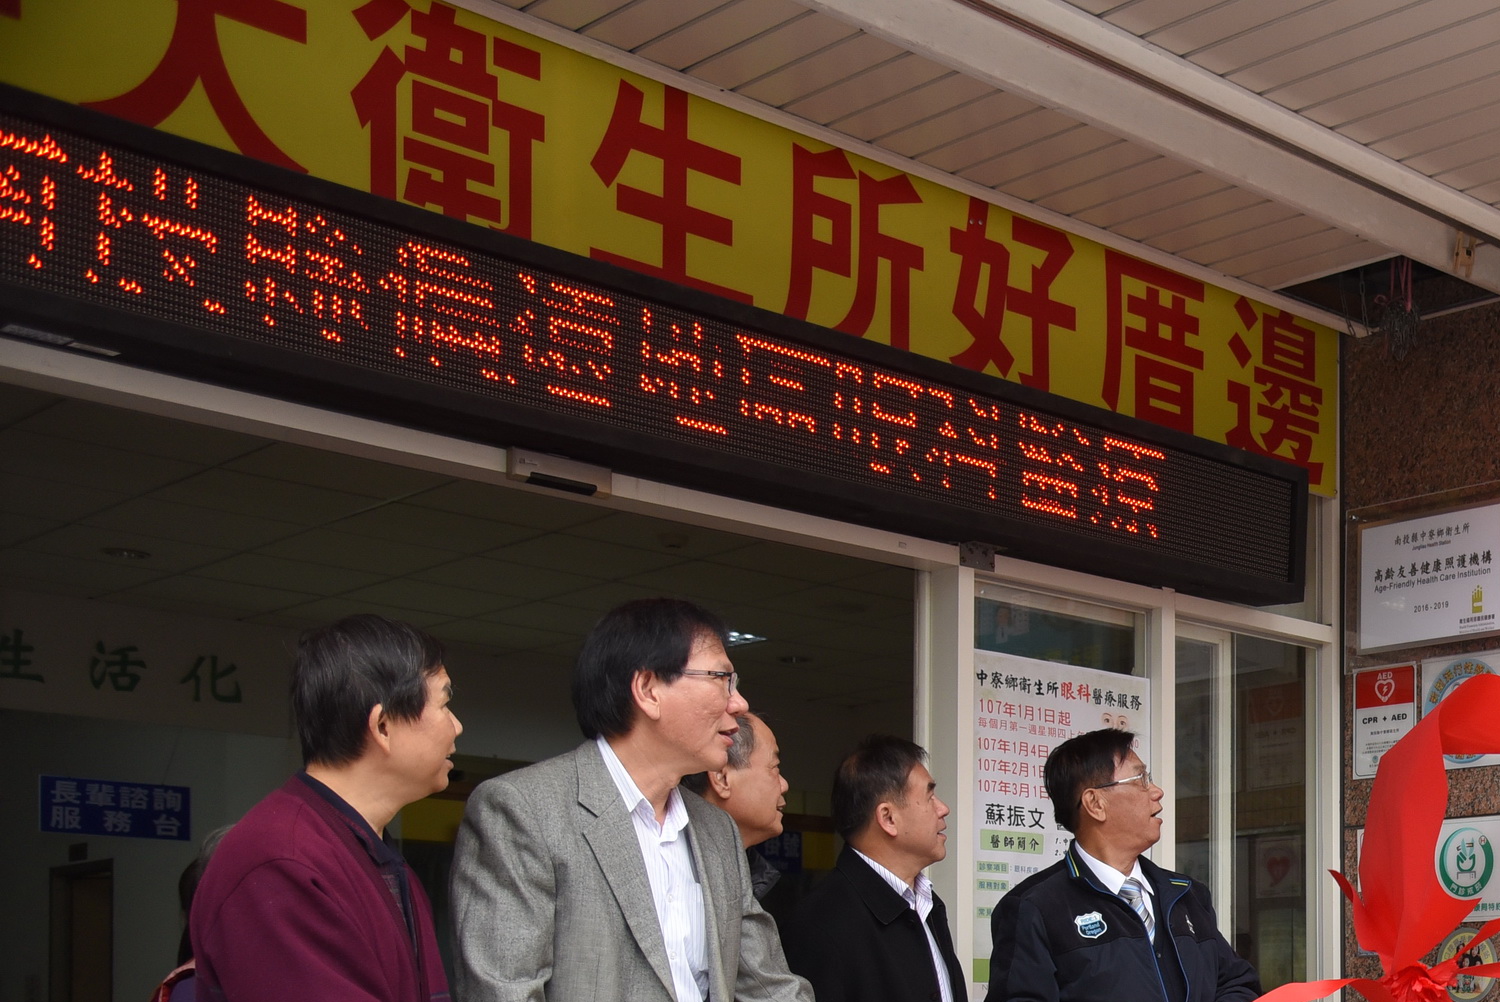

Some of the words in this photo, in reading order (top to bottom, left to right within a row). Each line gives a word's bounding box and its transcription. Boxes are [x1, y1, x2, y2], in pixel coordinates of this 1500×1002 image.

[0, 0, 1323, 485] 大衛生所好厝邊
[1394, 522, 1470, 546] 南投縣中寮鄉衛生所
[1374, 549, 1492, 582] 高齡友善健康照護機構
[1374, 579, 1415, 593] Age-Friendly
[1416, 575, 1438, 586] Health
[1440, 572, 1456, 582] Care
[1457, 567, 1491, 579] Institution
[1414, 603, 1429, 613] 2016
[1434, 601, 1449, 611] 2019
[1377, 671, 1393, 680] AED
[976, 669, 1142, 711] 中寮鄉衛生所眼科醫療服務
[979, 698, 1071, 726] 107年1月1日起
[1362, 716, 1378, 725] CPR
[1391, 713, 1407, 721] AED
[978, 737, 1049, 758] 107年1月4日
[49, 779, 183, 812] 長輩諮詢
[49, 805, 182, 838] 服務台
[985, 803, 1045, 829] 蘇振文
[990, 834, 1040, 851] 醫師簡介
